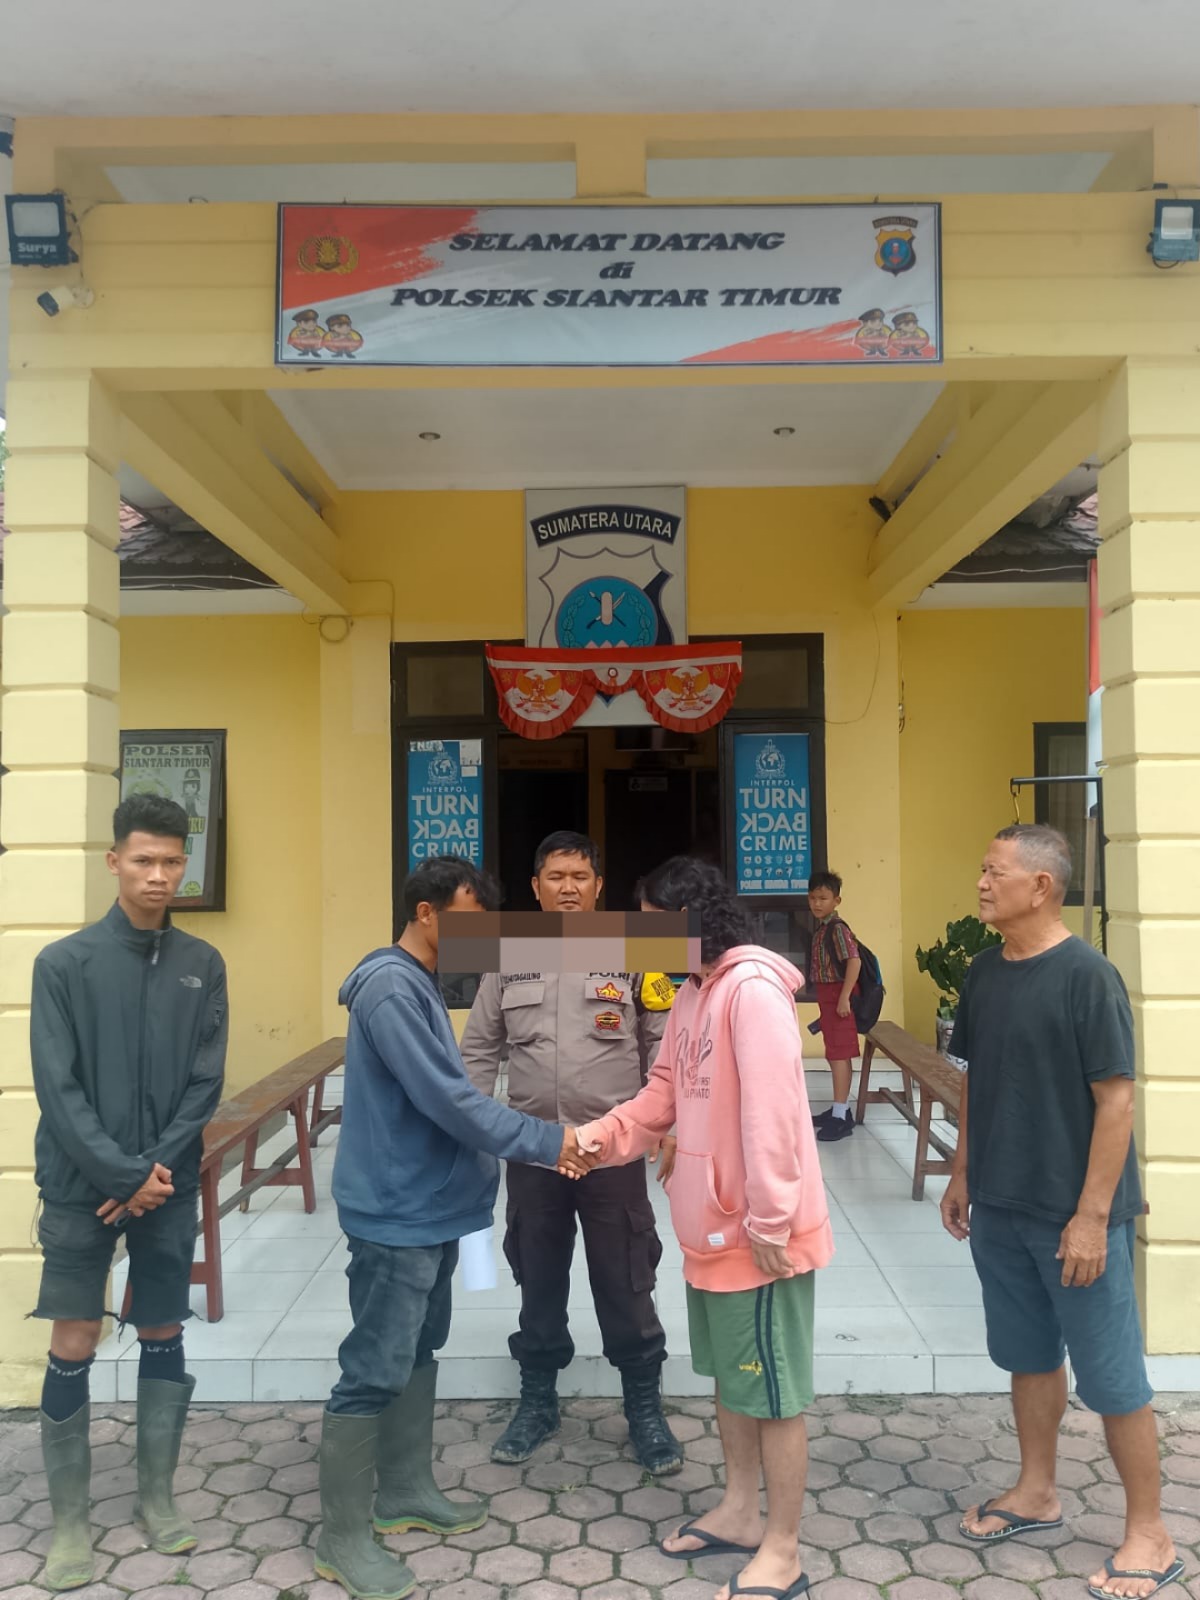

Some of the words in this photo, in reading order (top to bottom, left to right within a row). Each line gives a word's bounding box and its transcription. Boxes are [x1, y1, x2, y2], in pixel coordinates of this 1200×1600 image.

[18, 243, 57, 254] Surya
[449, 234, 627, 251] SELAMAT
[631, 233, 786, 251] DATANG
[599, 261, 634, 279] di
[391, 289, 536, 307] POLSEK
[542, 288, 709, 308] SIANTAR
[719, 287, 842, 307] TIMUR
[538, 511, 619, 540] SUMATERA
[623, 511, 673, 538] UTARA
[126, 746, 210, 756] POLSEK
[124, 758, 171, 769] SIANTAR
[174, 758, 210, 768] TIMUR
[411, 793, 479, 816] TURN
[739, 787, 807, 809] TURN
[412, 842, 480, 858] CRIME
[740, 835, 808, 851] CRIME
